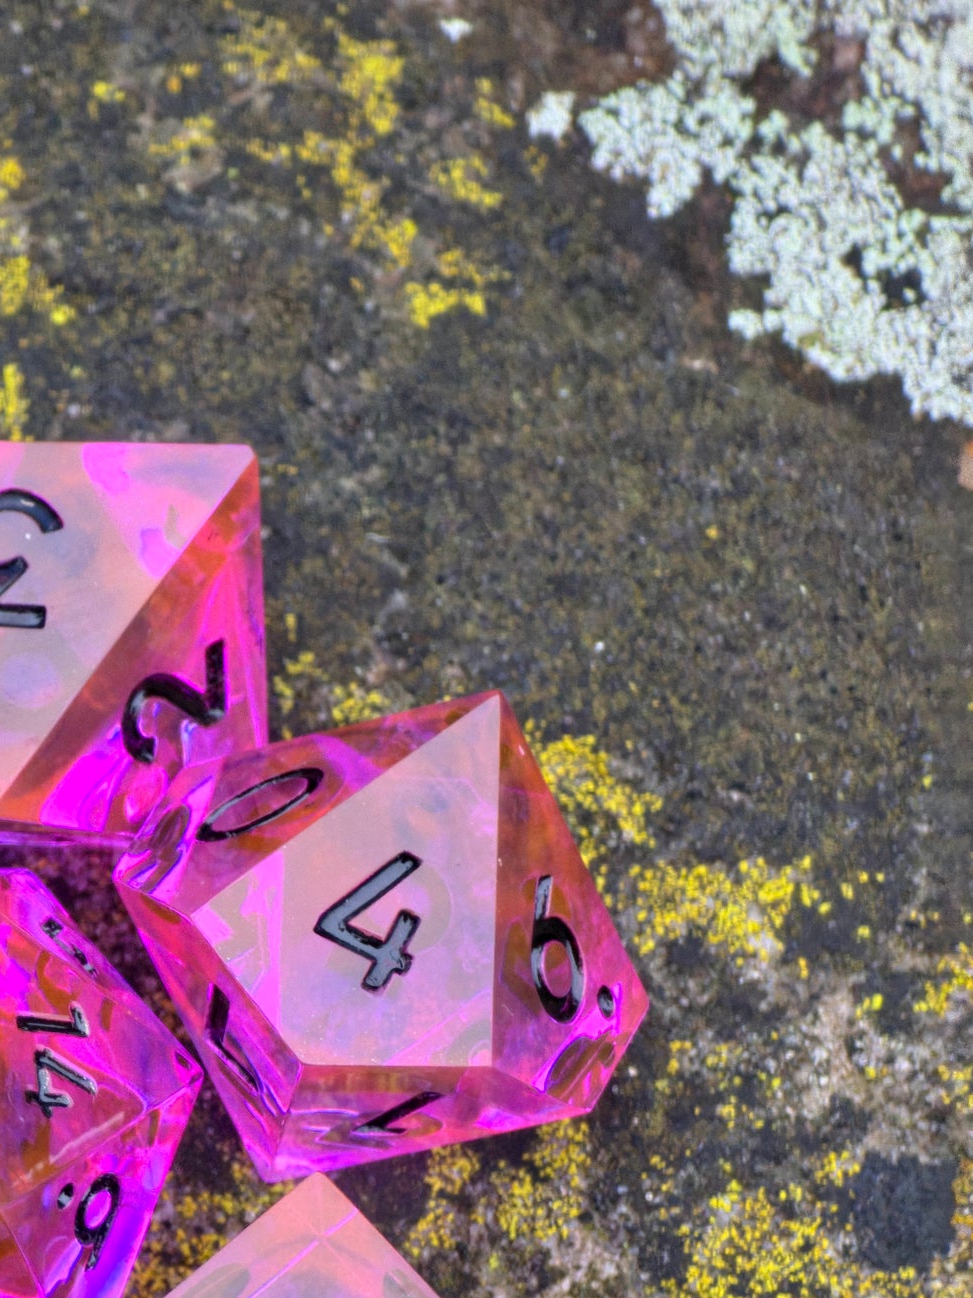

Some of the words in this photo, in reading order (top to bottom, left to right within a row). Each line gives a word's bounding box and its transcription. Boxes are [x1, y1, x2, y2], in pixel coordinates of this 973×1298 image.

[121, 637, 226, 764] 2
[195, 767, 325, 842] 0
[313, 850, 422, 994] 4
[15, 1000, 98, 1118] 14
